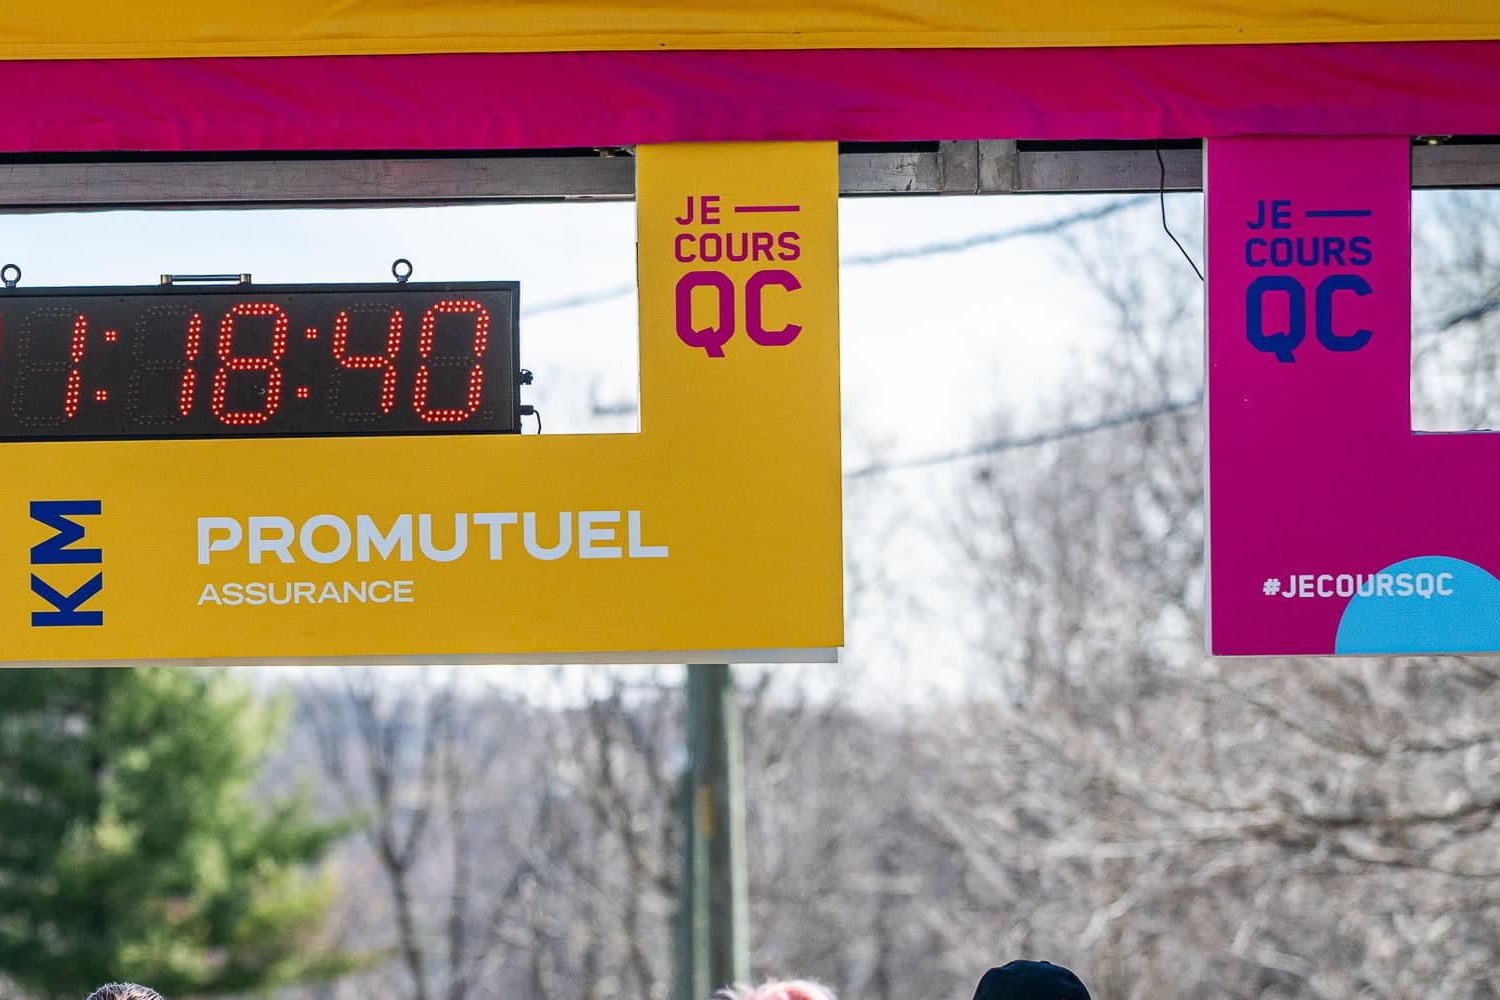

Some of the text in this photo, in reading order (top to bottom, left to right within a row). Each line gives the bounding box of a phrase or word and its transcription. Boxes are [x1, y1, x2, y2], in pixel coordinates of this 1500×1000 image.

[675, 195, 721, 226] JE
[1246, 199, 1293, 231] JE
[674, 231, 801, 263] COURS
[1245, 236, 1373, 268] COURS
[674, 269, 803, 359] QC
[1245, 274, 1374, 364] QC
[196, 509, 670, 566] PROMUTUEL
[29, 500, 104, 628] KM
[196, 579, 415, 606] ASSURANCE
[1262, 572, 1455, 599] #JECOURSQC
